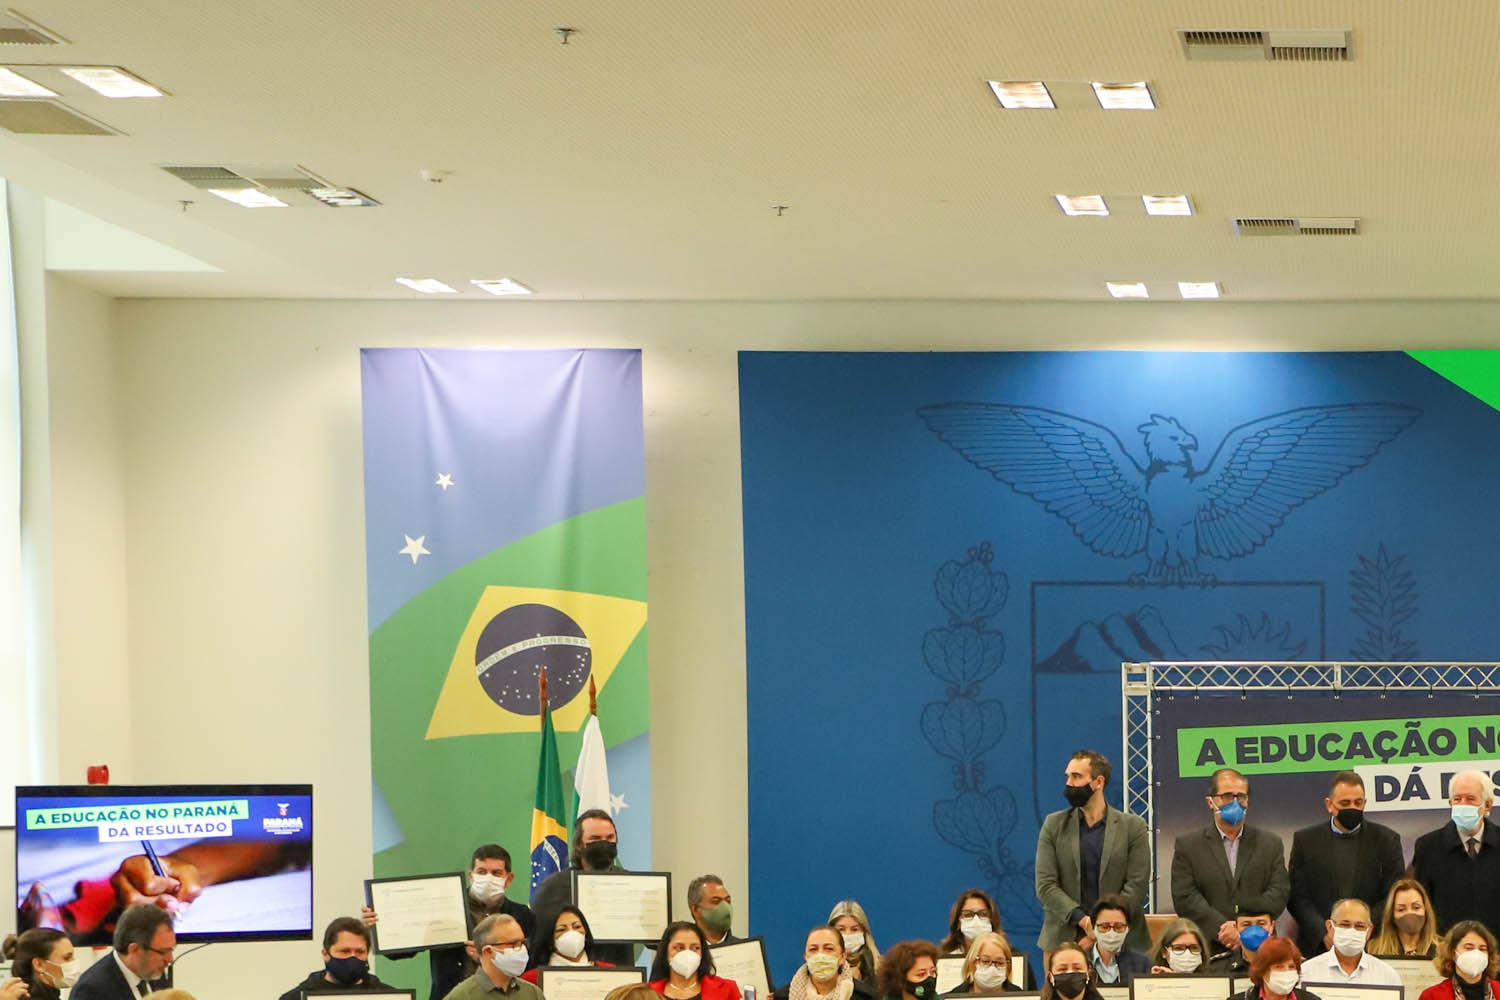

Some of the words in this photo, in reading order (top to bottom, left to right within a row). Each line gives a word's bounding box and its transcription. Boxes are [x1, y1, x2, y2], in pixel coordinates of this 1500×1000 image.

[1195, 738, 1226, 767] A
[1235, 720, 1457, 764] EDUCAÇÃO
[1374, 765, 1431, 802] DÁ
[35, 814, 47, 825] A
[51, 807, 141, 824] EDUCAÇÃO
[146, 808, 169, 819] NO
[173, 802, 239, 818] PARANÁ
[135, 822, 227, 836] RESULTADO
